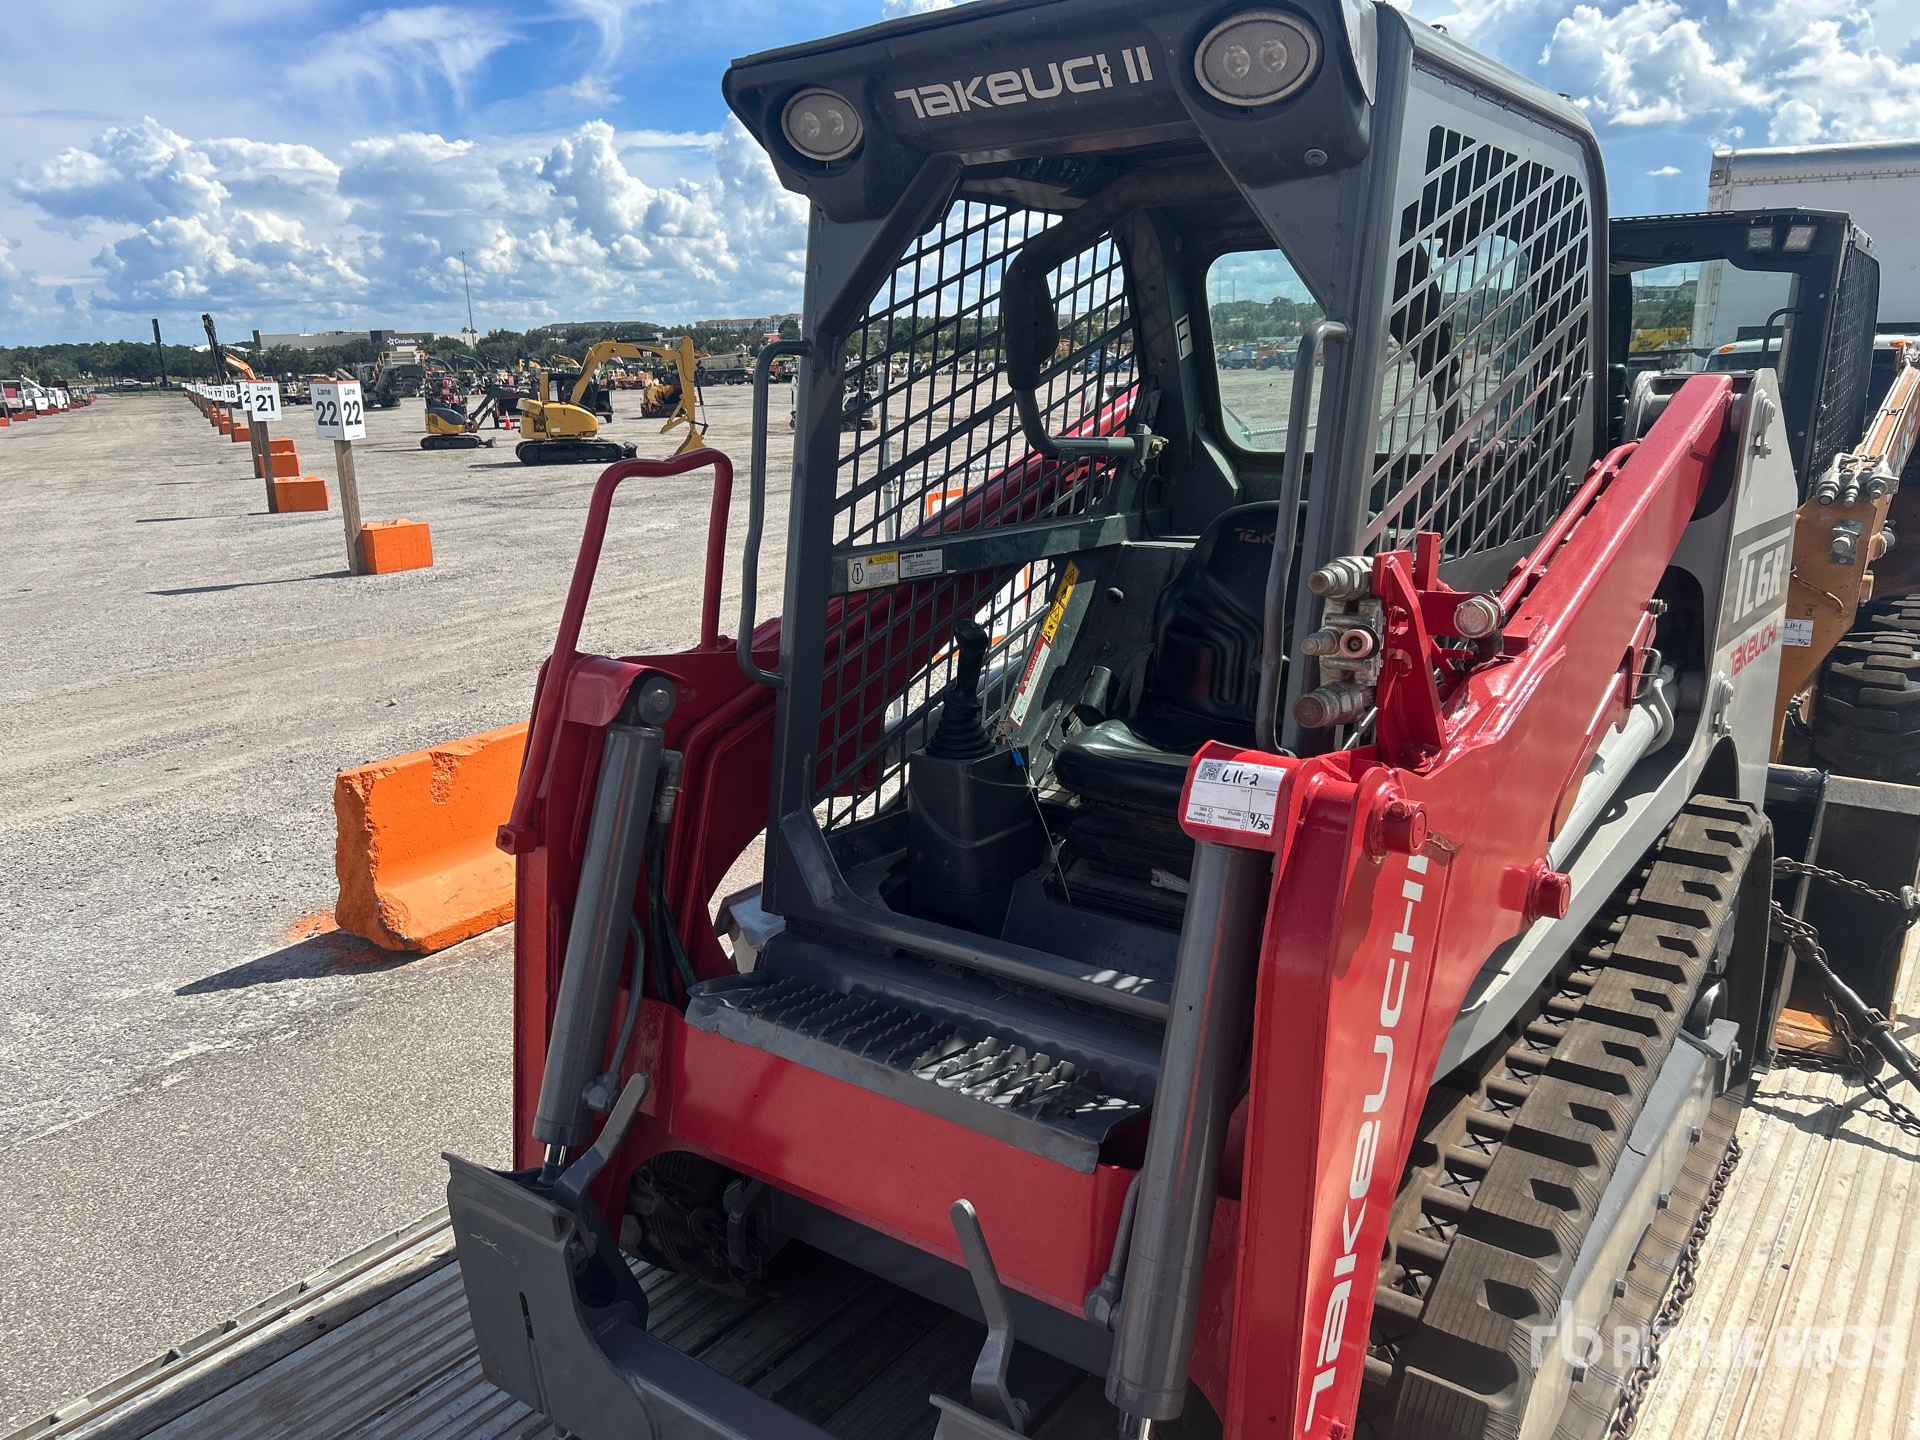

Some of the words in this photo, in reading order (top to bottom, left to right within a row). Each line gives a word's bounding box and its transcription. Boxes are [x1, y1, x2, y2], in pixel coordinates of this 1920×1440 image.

[226, 390, 236, 398] 18
[256, 395, 275, 412] 21
[316, 401, 339, 426] 22
[343, 400, 362, 425] 22
[1733, 526, 1791, 623] TL6R
[1730, 618, 1777, 678] TAKEUCHI
[1026, 650, 1040, 678] DANGER
[1218, 815, 1241, 823] Inspection
[1249, 813, 1270, 830] 9/30
[1303, 855, 1429, 1433] TAKEUCHI
